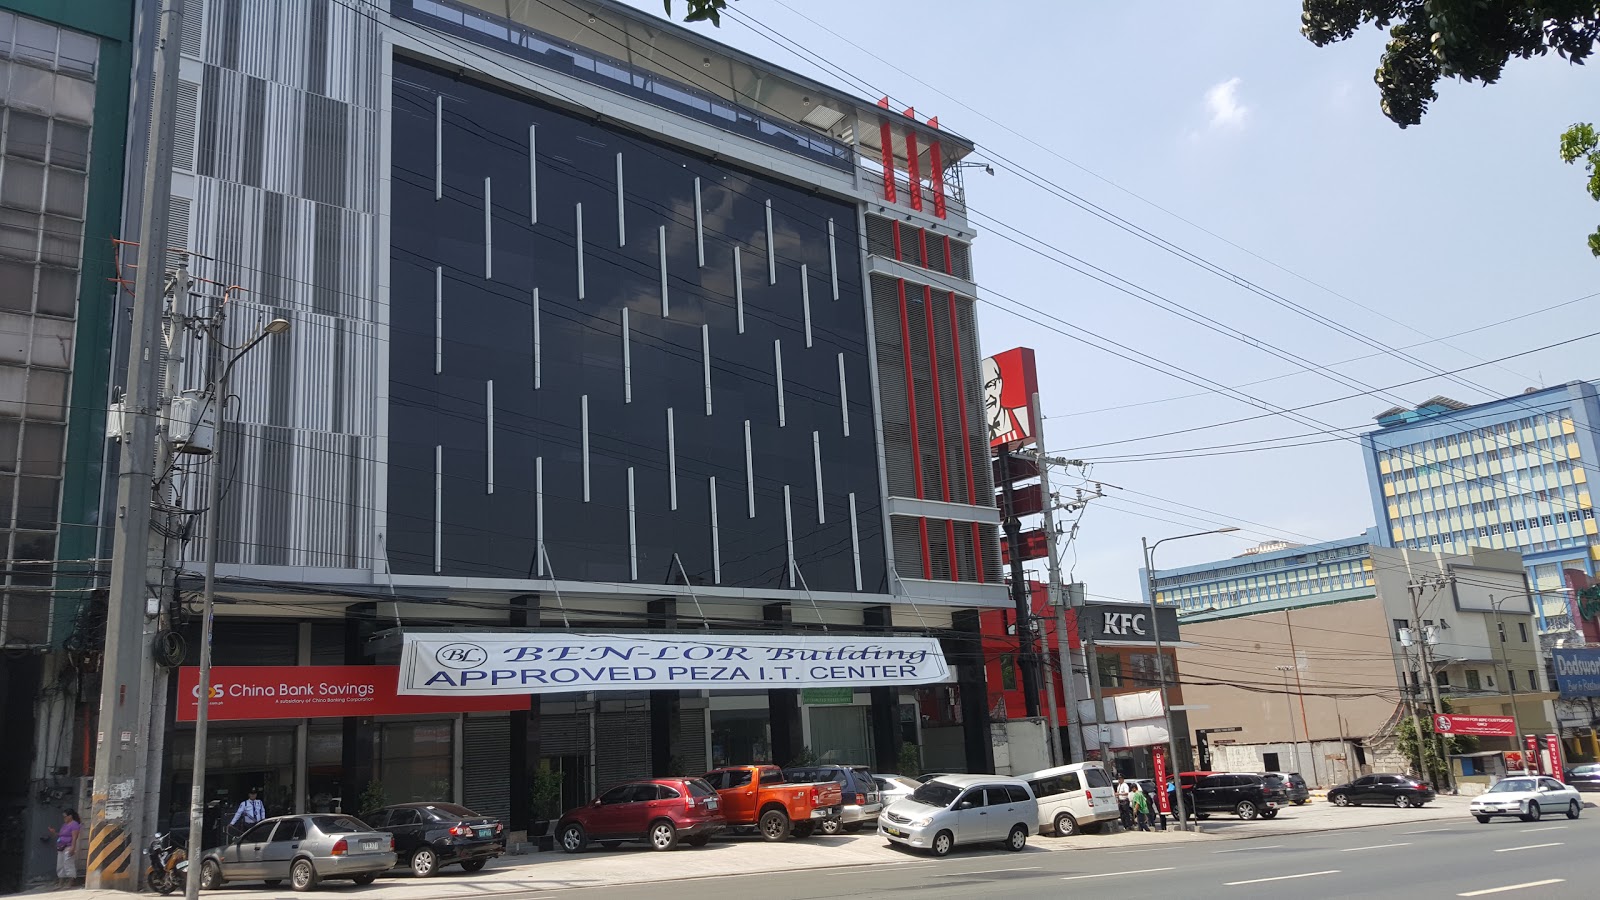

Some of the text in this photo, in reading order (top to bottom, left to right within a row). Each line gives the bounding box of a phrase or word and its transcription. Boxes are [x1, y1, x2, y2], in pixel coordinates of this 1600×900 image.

[1103, 612, 1146, 635] KFC
[503, 645, 927, 664] BEN-LOR Building
[1556, 654, 1600, 676] Dodswor
[424, 665, 918, 687] APPROVED PEZA I.T. CENTER
[229, 682, 375, 697] China Bank Savings
[1554, 766, 1562, 782] THR
